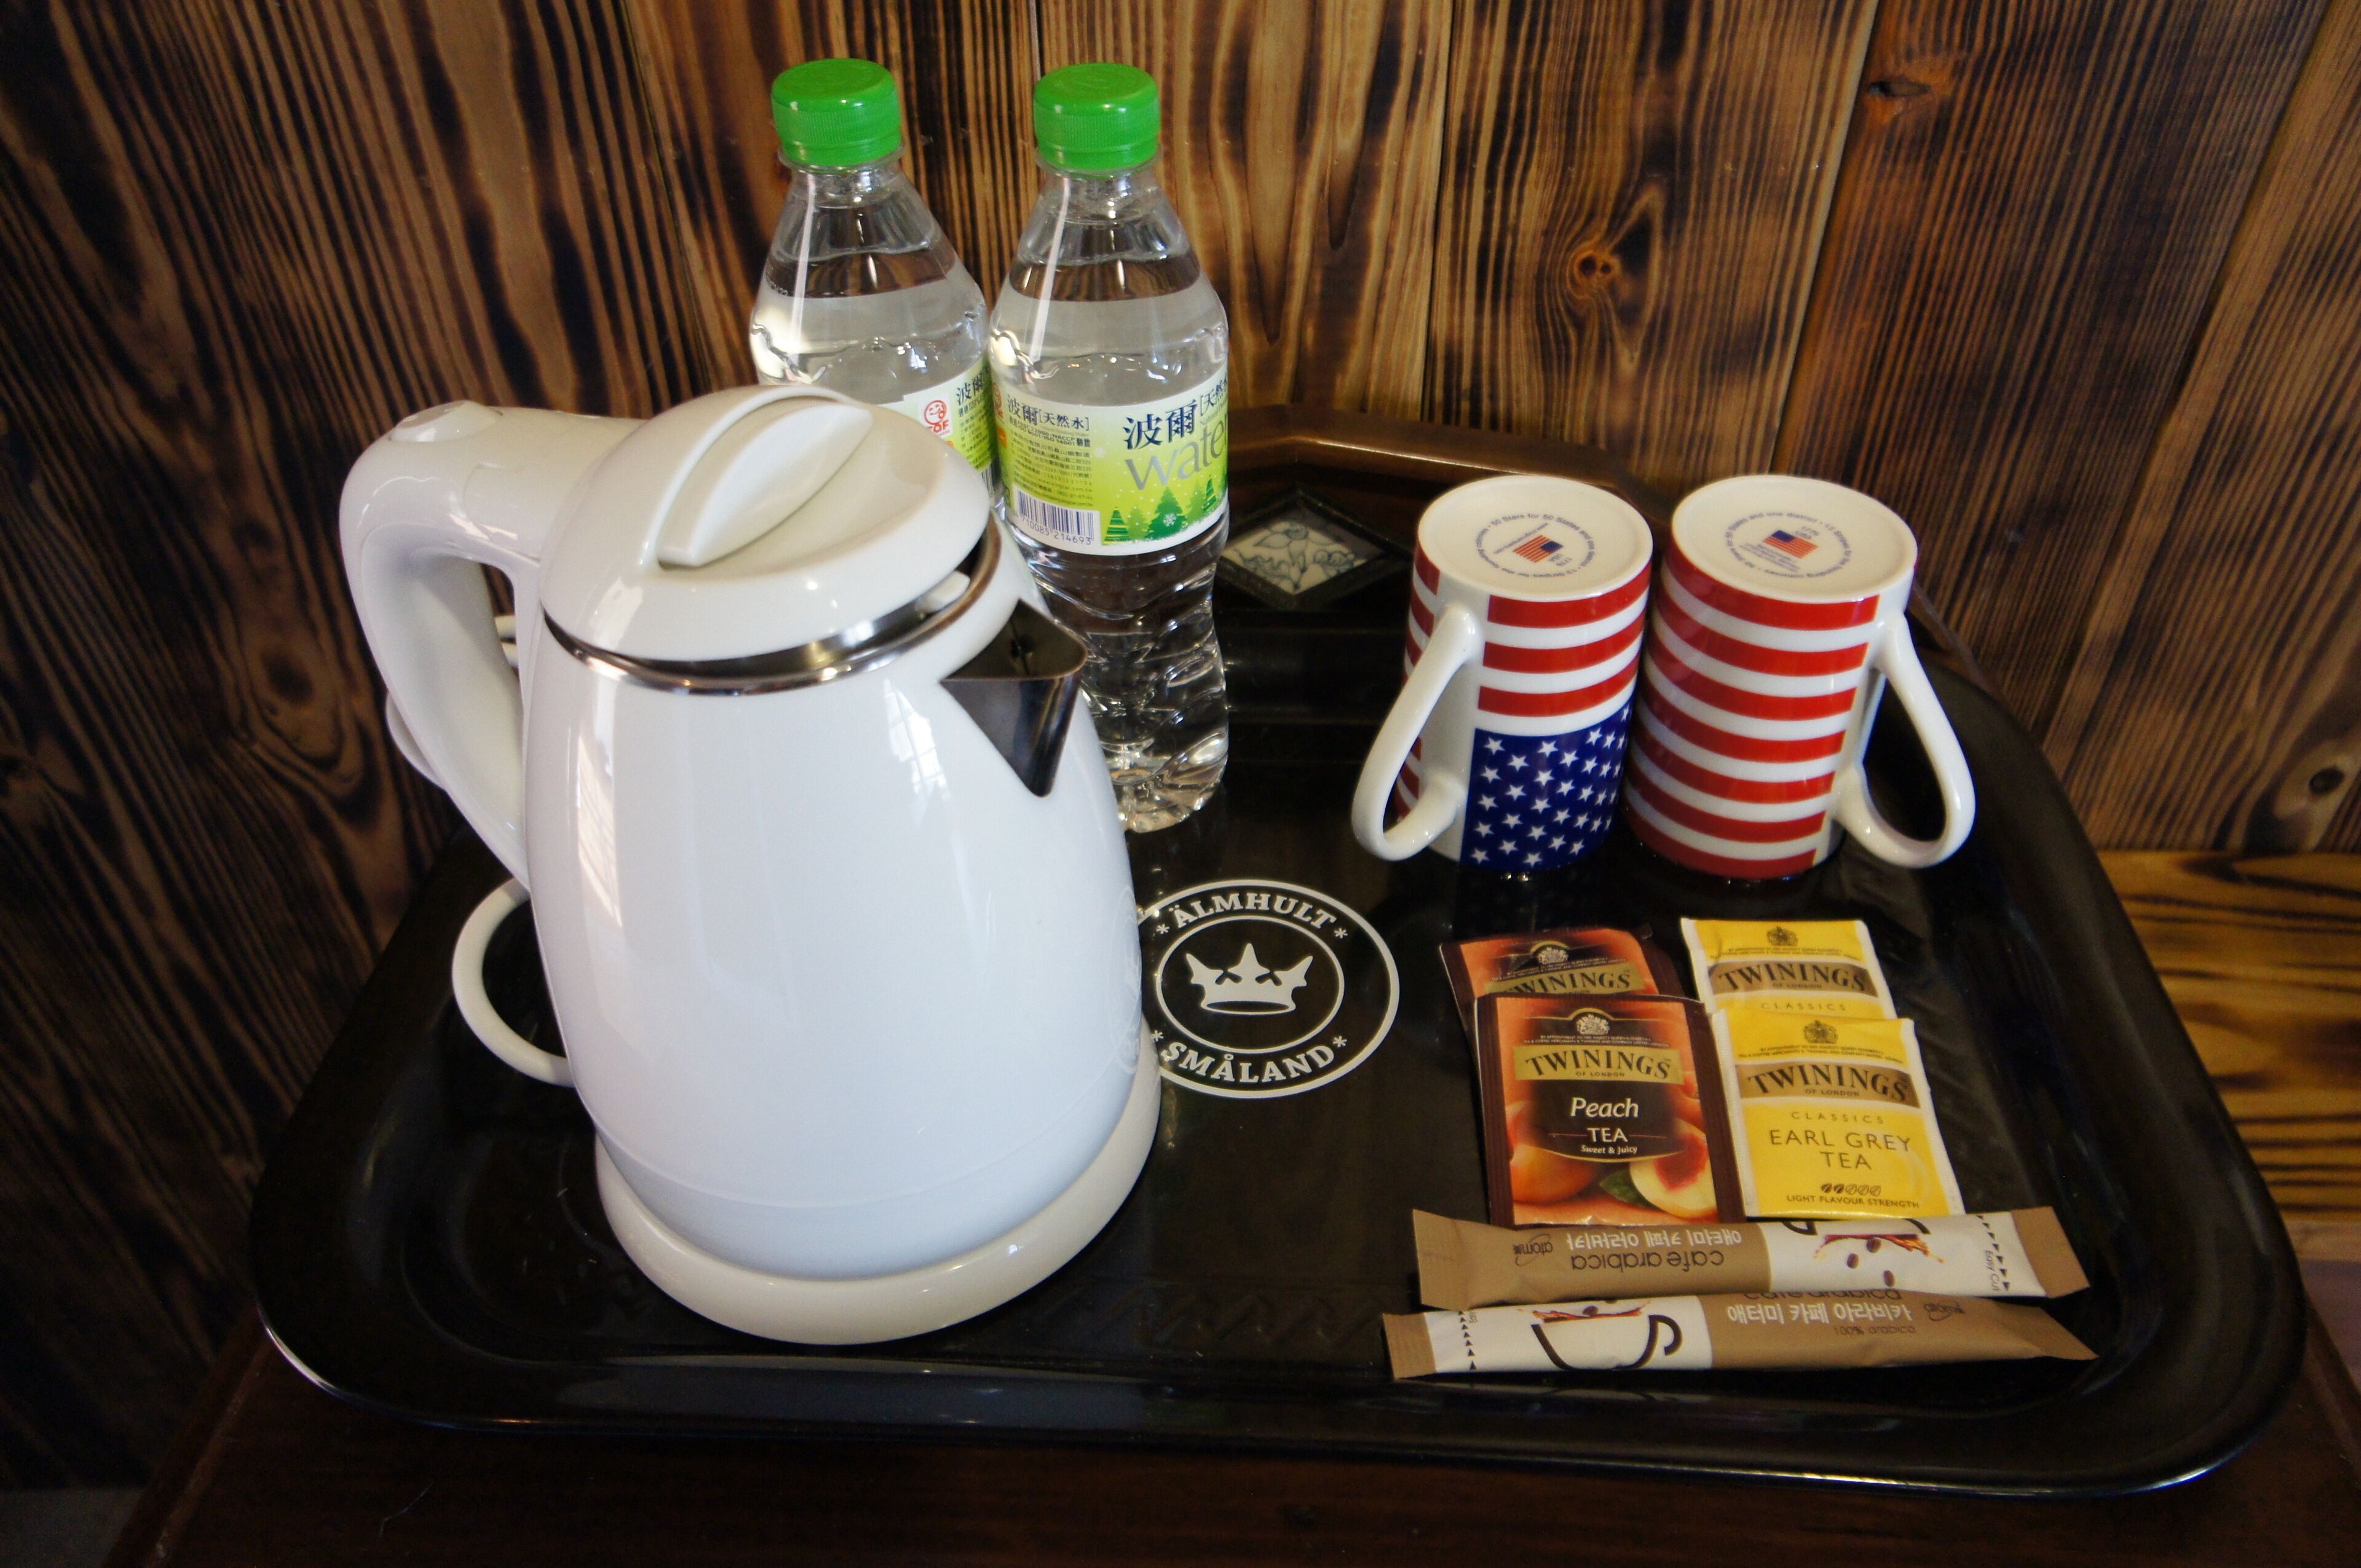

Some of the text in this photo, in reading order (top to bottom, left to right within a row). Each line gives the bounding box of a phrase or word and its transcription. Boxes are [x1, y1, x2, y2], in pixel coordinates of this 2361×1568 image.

[1123, 399, 1198, 450] 波爾
[1054, 531, 1091, 545] 214693
[1168, 892, 1337, 929] ÄLMHULT
[1509, 972, 1631, 993] WININGS
[1718, 963, 1865, 991] TWININGS
[1762, 1003, 1846, 1011] CLASSICS
[1161, 1041, 1335, 1083] SMÅLAND
[1525, 1049, 1671, 1080] TWININGS
[1747, 1064, 1908, 1103] TWININGS
[1570, 1097, 1639, 1117] Peach
[1791, 1111, 1884, 1124] CLASSICS
[1587, 1127, 1628, 1142] TEA
[1770, 1130, 1910, 1151] EARL GREY
[1581, 1144, 1605, 1154] Sweet
[1617, 1145, 1638, 1155] Juicy
[1819, 1151, 1872, 1170] TEA
[1819, 1196, 1864, 1205] FLAVOUR
[1868, 1198, 1920, 1208] STRENGTH
[1567, 1229, 1742, 1250] 애터미 카페 아라비카
[1571, 1250, 1724, 1273] cafe arabica
[1985, 1250, 2001, 1291] Easy Cut
[1727, 1302, 1913, 1324] 애터미 카페 아라비카
[1834, 1324, 1916, 1336] 100% arabica
